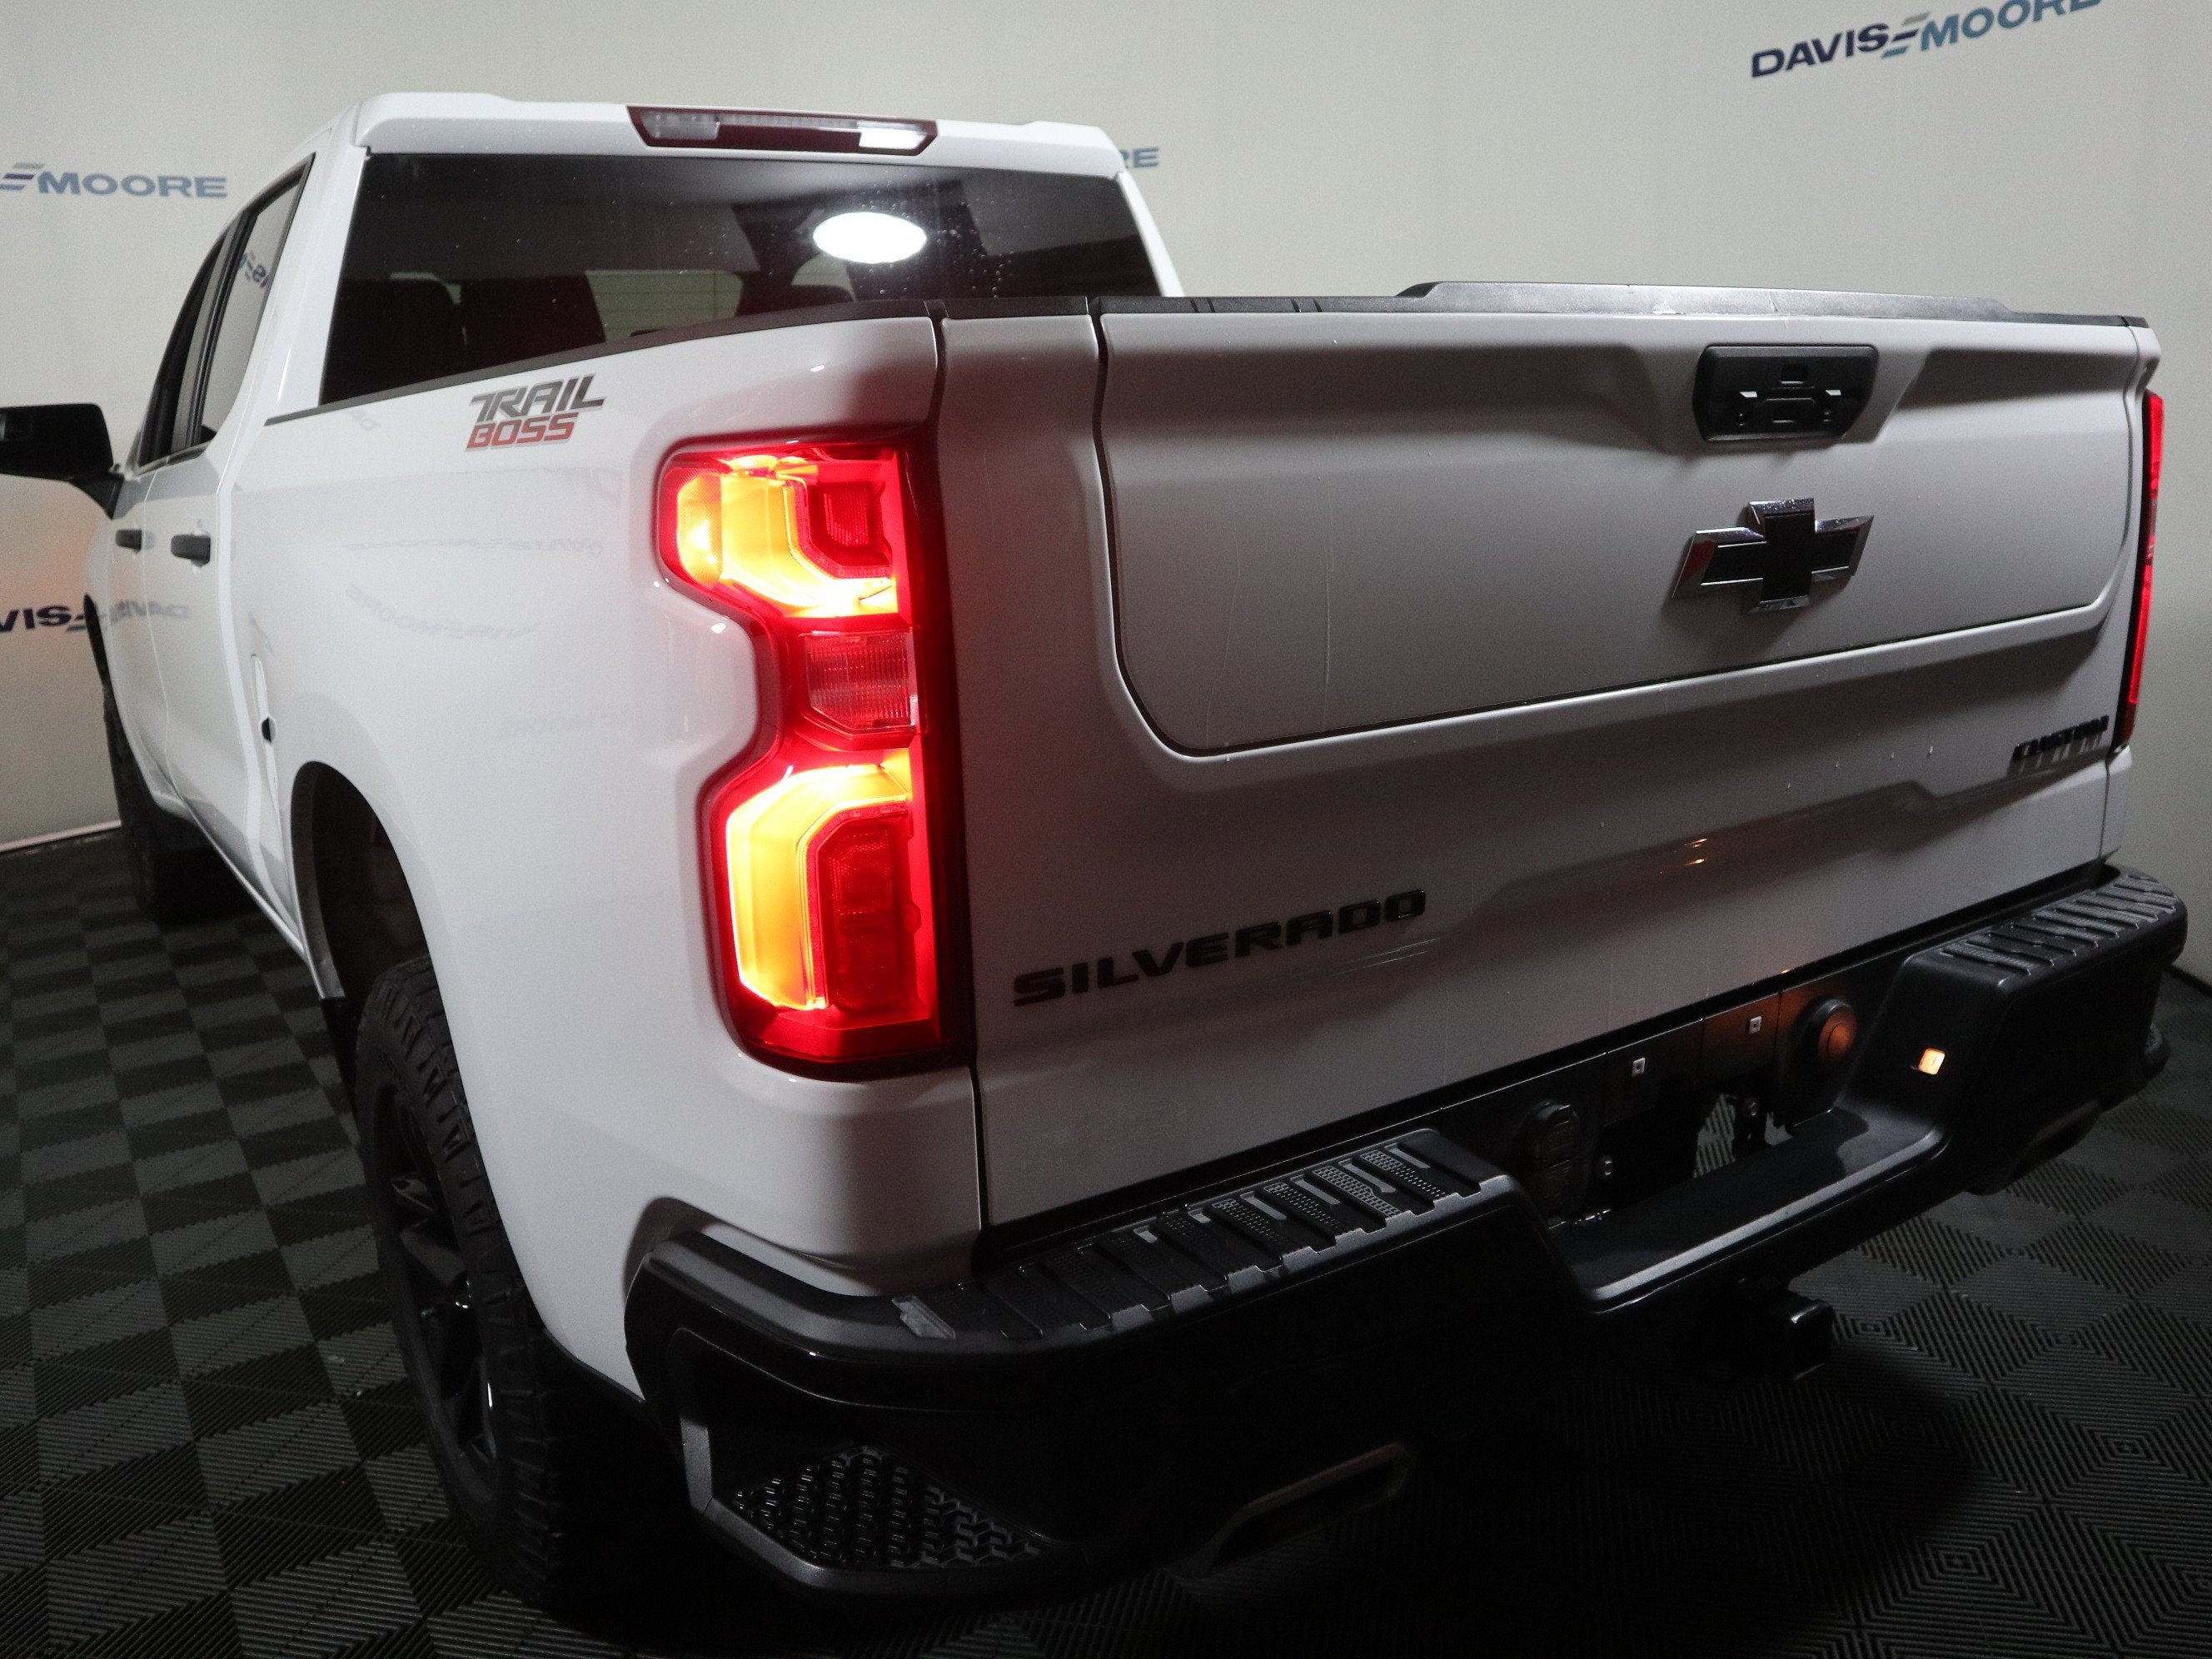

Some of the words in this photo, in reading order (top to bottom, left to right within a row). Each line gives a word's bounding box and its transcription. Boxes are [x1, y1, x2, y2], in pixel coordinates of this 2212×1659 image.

[1751, 22, 1890, 77] DAVIS
[37, 171, 228, 197] MOORE
[469, 374, 605, 422] TRAIL
[466, 411, 580, 451] BOSS
[1013, 888, 1427, 1007] SILVERADO
